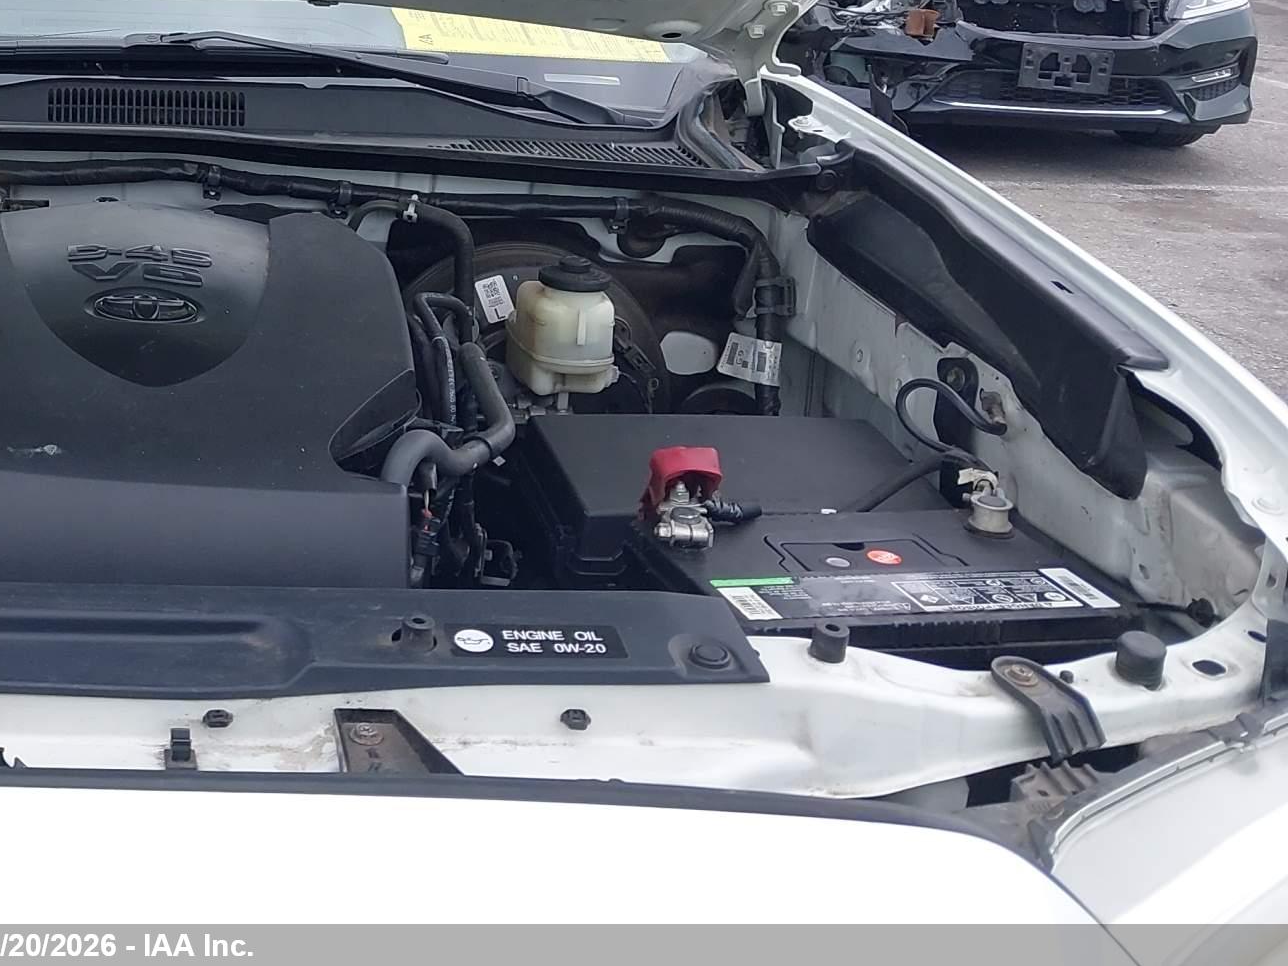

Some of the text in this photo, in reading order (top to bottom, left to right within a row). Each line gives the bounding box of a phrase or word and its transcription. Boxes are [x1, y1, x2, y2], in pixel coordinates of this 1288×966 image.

[502, 630, 603, 641] ENGINE OIL
[507, 642, 606, 654] SAE 0W-20
